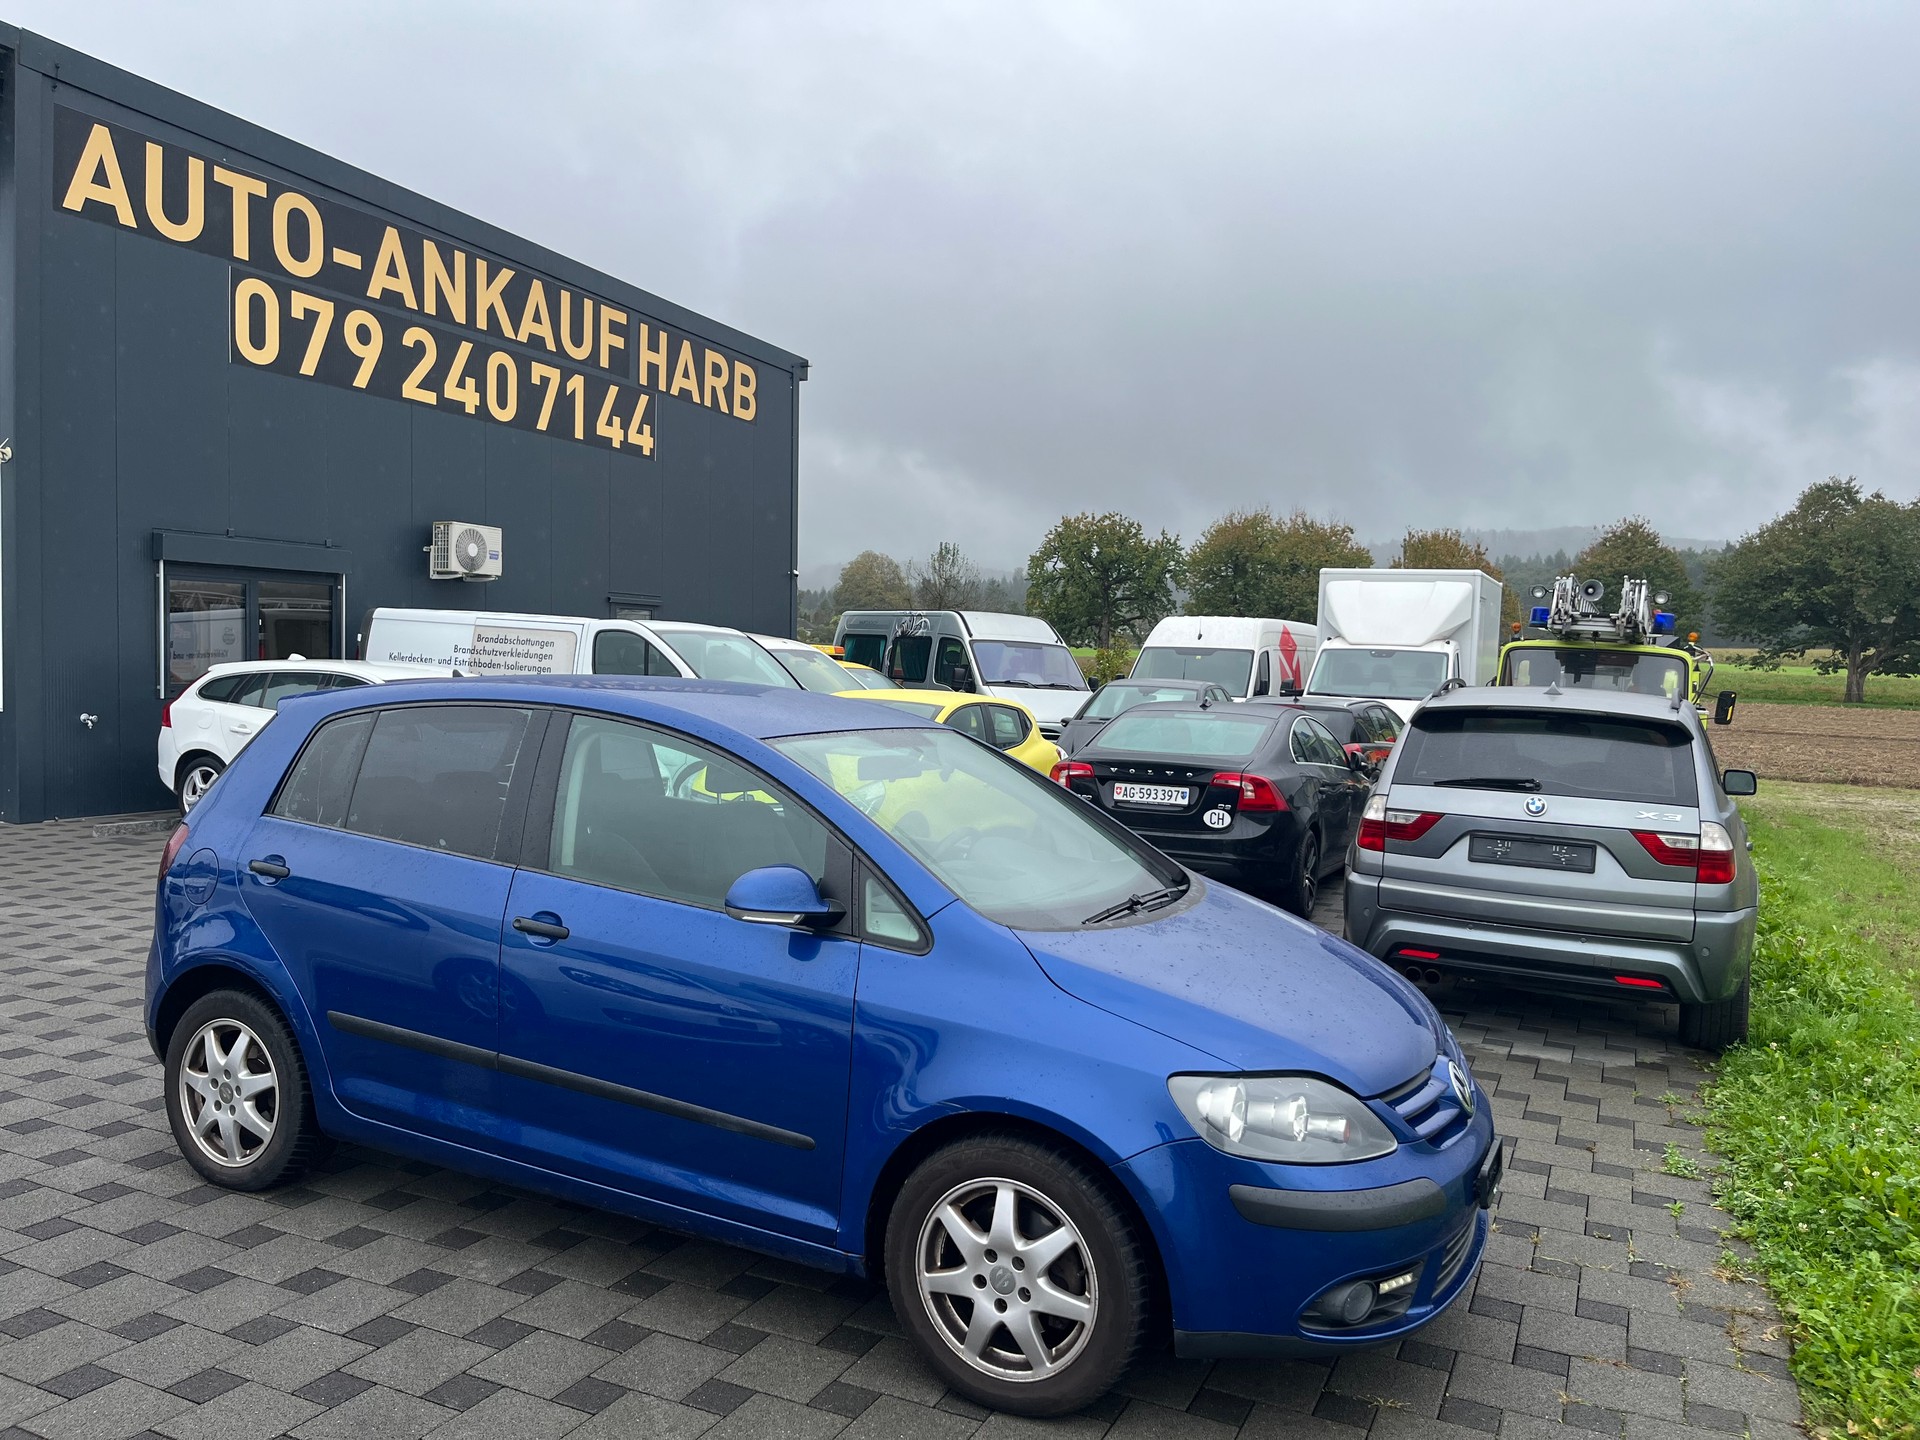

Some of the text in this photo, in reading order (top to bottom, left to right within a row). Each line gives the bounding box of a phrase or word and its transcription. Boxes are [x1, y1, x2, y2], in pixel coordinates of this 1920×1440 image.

[63, 123, 757, 422] AUTO-ANKAUF HARB
[234, 278, 383, 389] 079
[402, 327, 518, 423] 240
[477, 633, 555, 649] Brandabschottungen
[453, 644, 553, 662] Brandschutzverkleidungen
[388, 652, 436, 665] Kellerdecken-
[437, 656, 452, 667] und
[453, 656, 552, 674] Estrichboden-Isolierungen
[1210, 811, 1225, 826] CH
[1635, 810, 1682, 822] X3
